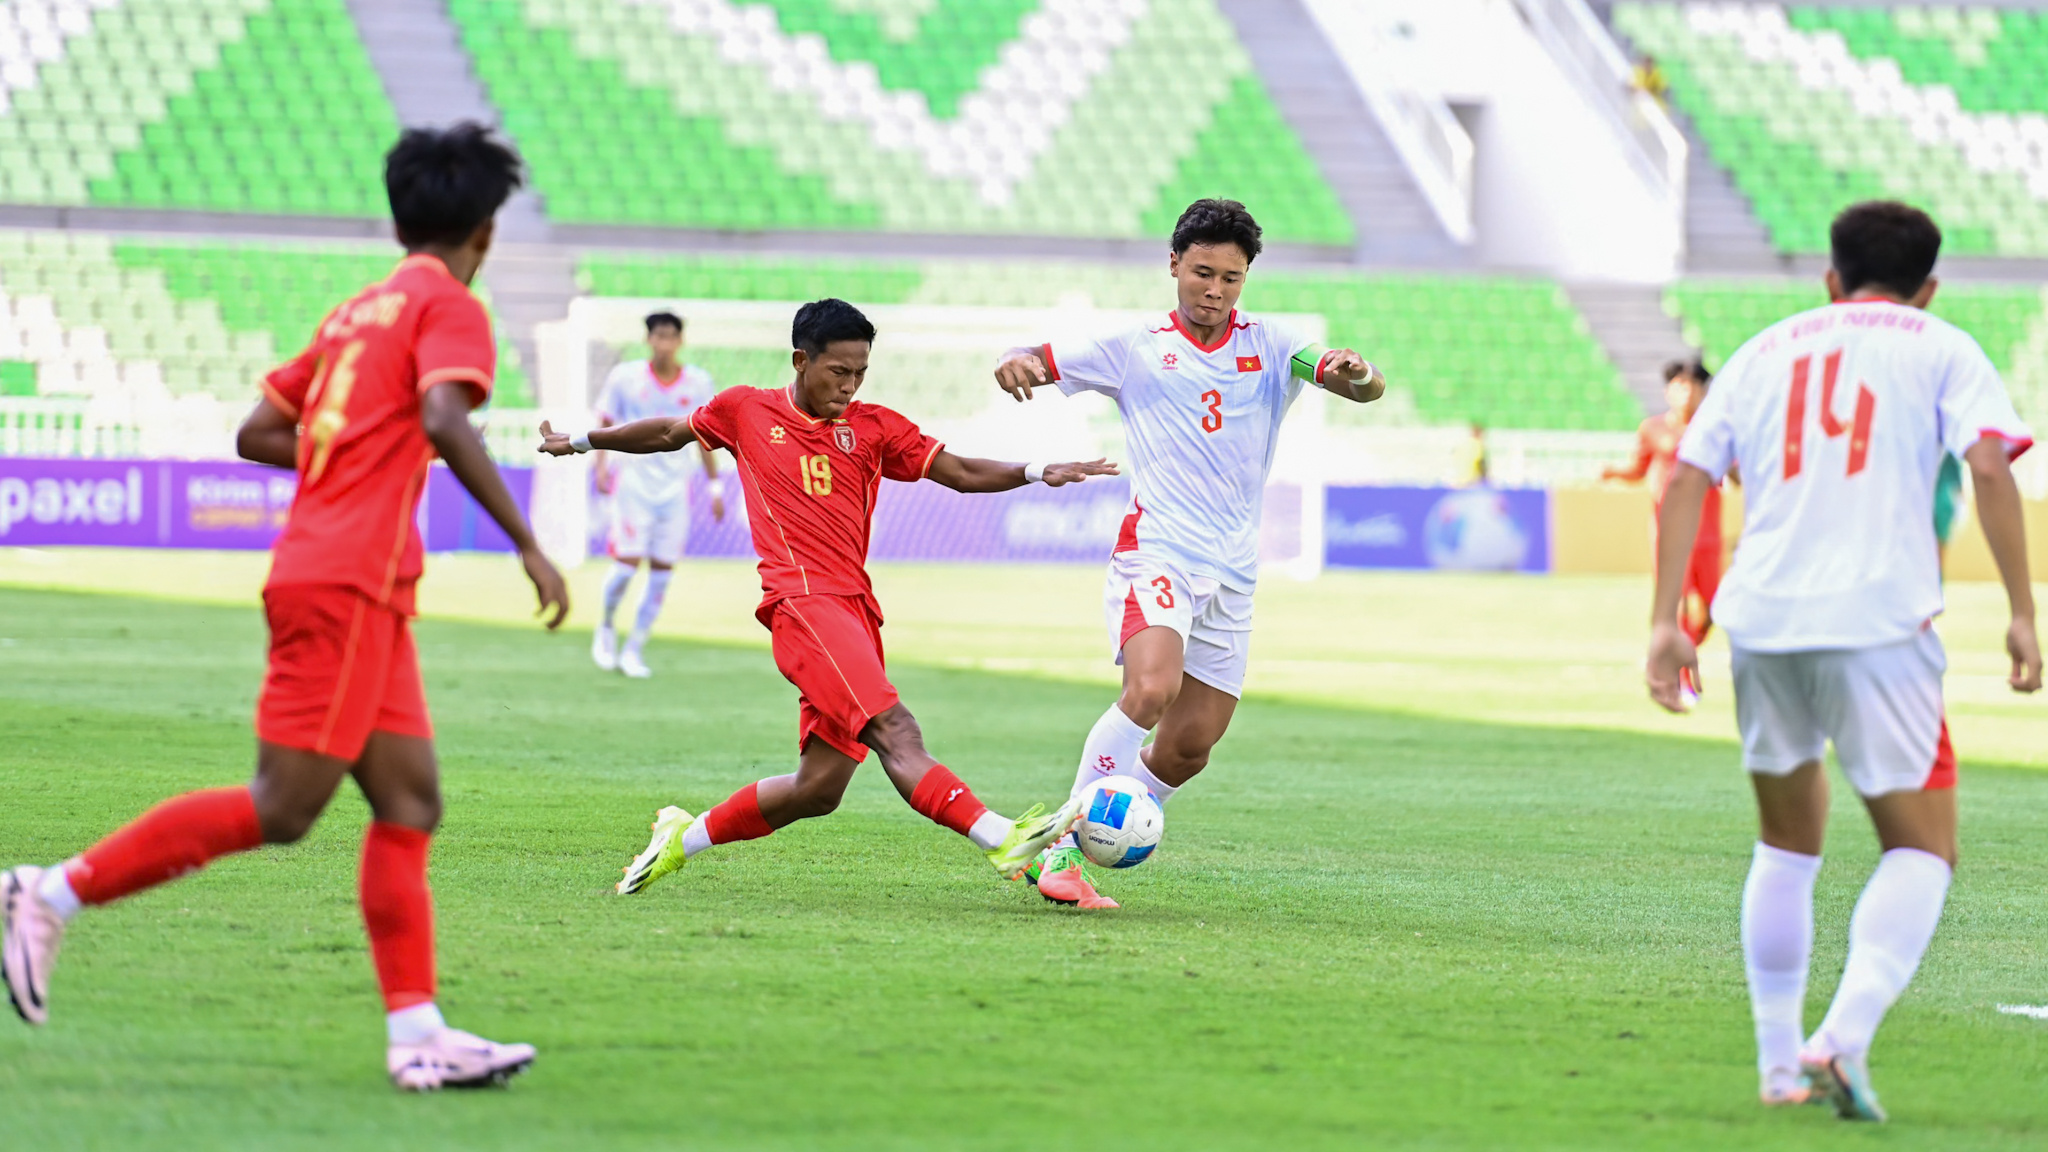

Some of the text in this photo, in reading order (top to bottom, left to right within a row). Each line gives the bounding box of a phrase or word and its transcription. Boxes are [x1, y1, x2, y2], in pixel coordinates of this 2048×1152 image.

[1201, 388, 1223, 434] 3
[1783, 347, 1877, 482] 14
[800, 454, 833, 496] 19
[0, 465, 143, 537] paxel
[1150, 575, 1175, 609] 3
